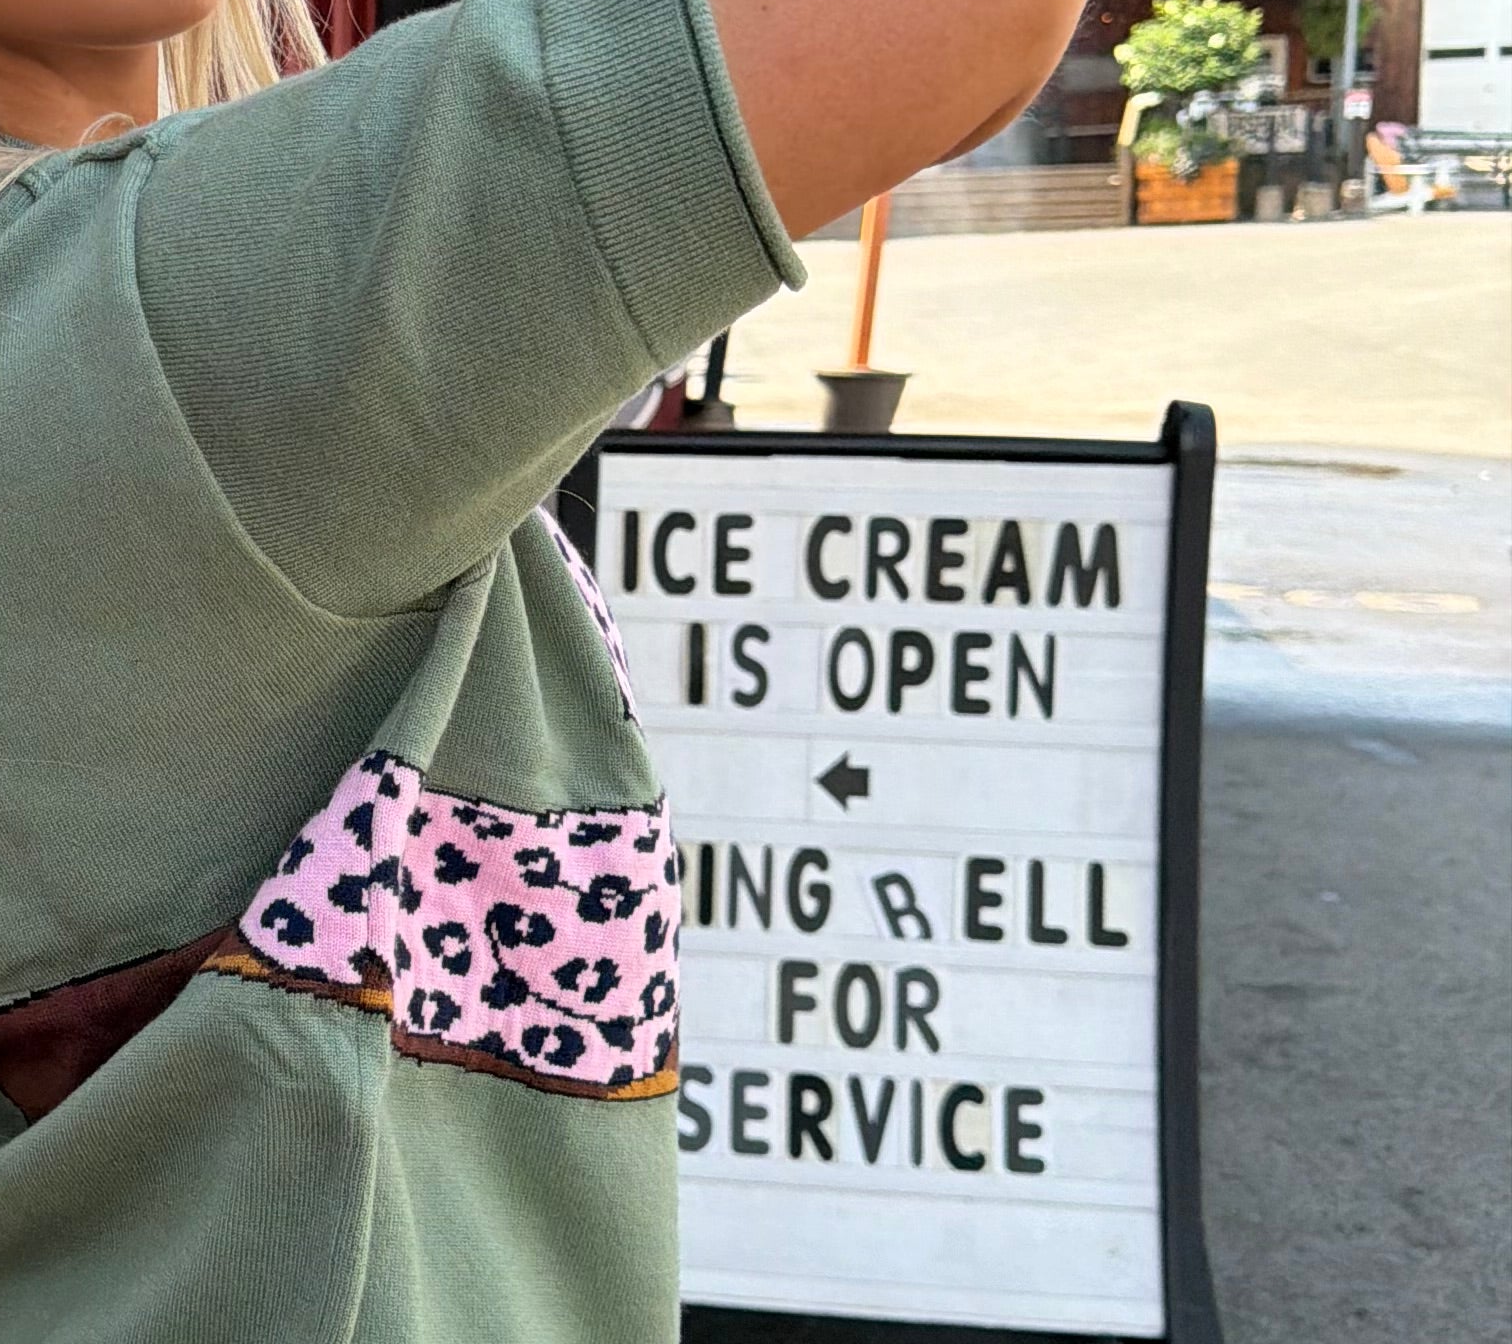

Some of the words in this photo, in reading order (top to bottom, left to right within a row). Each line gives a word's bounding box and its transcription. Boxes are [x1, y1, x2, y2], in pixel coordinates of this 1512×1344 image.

[624, 509, 754, 596] ICE
[805, 515, 1121, 609] CREAM
[688, 622, 770, 708] IS
[829, 627, 1056, 719] OPEN
[679, 844, 832, 932] ING
[776, 959, 941, 1053] FOR
[679, 1067, 1046, 1175] SERVICE
